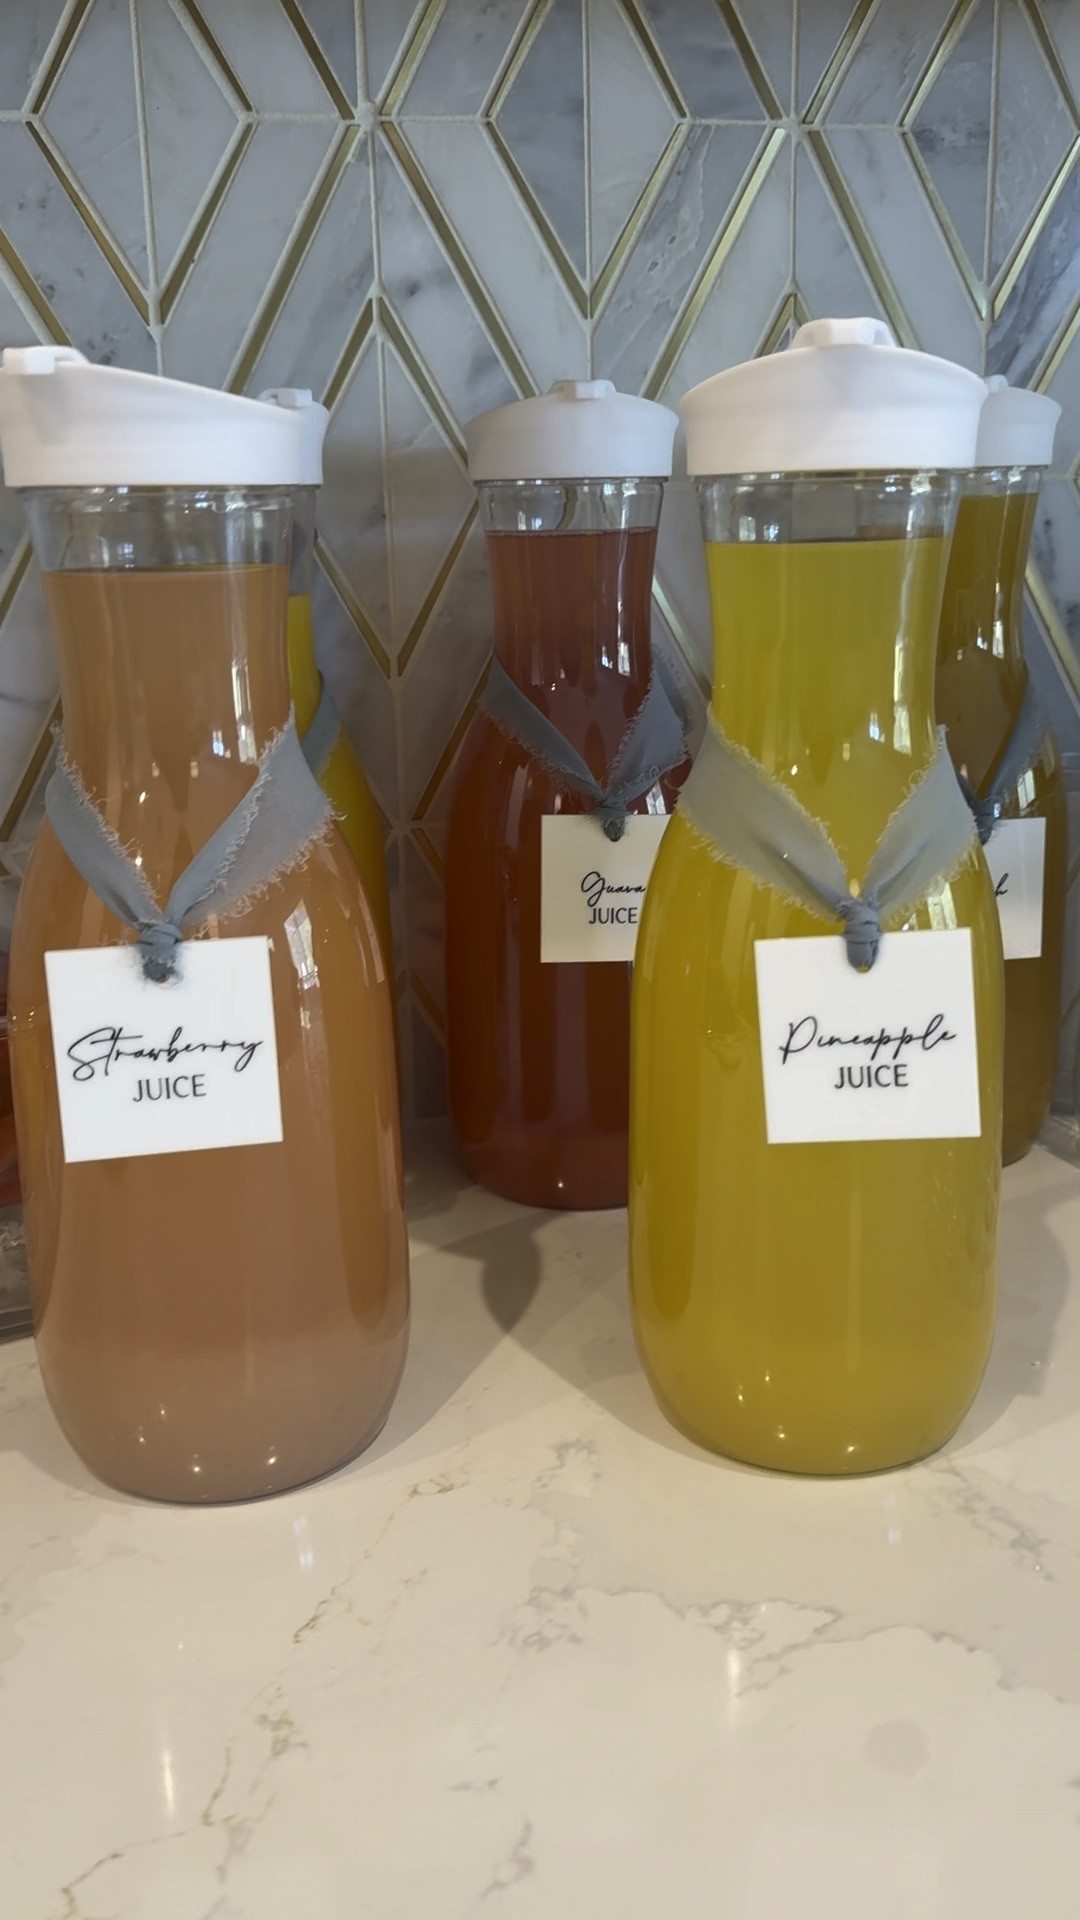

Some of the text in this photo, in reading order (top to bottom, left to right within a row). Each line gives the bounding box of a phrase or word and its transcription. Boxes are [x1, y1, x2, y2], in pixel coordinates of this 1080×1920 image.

[580, 870, 646, 908] Guava
[588, 907, 638, 925] JUICE
[67, 1026, 263, 1082] Strawberry
[778, 1012, 957, 1065] Pineapple
[132, 1074, 207, 1102] JUICE
[834, 1064, 909, 1089] JUICE
